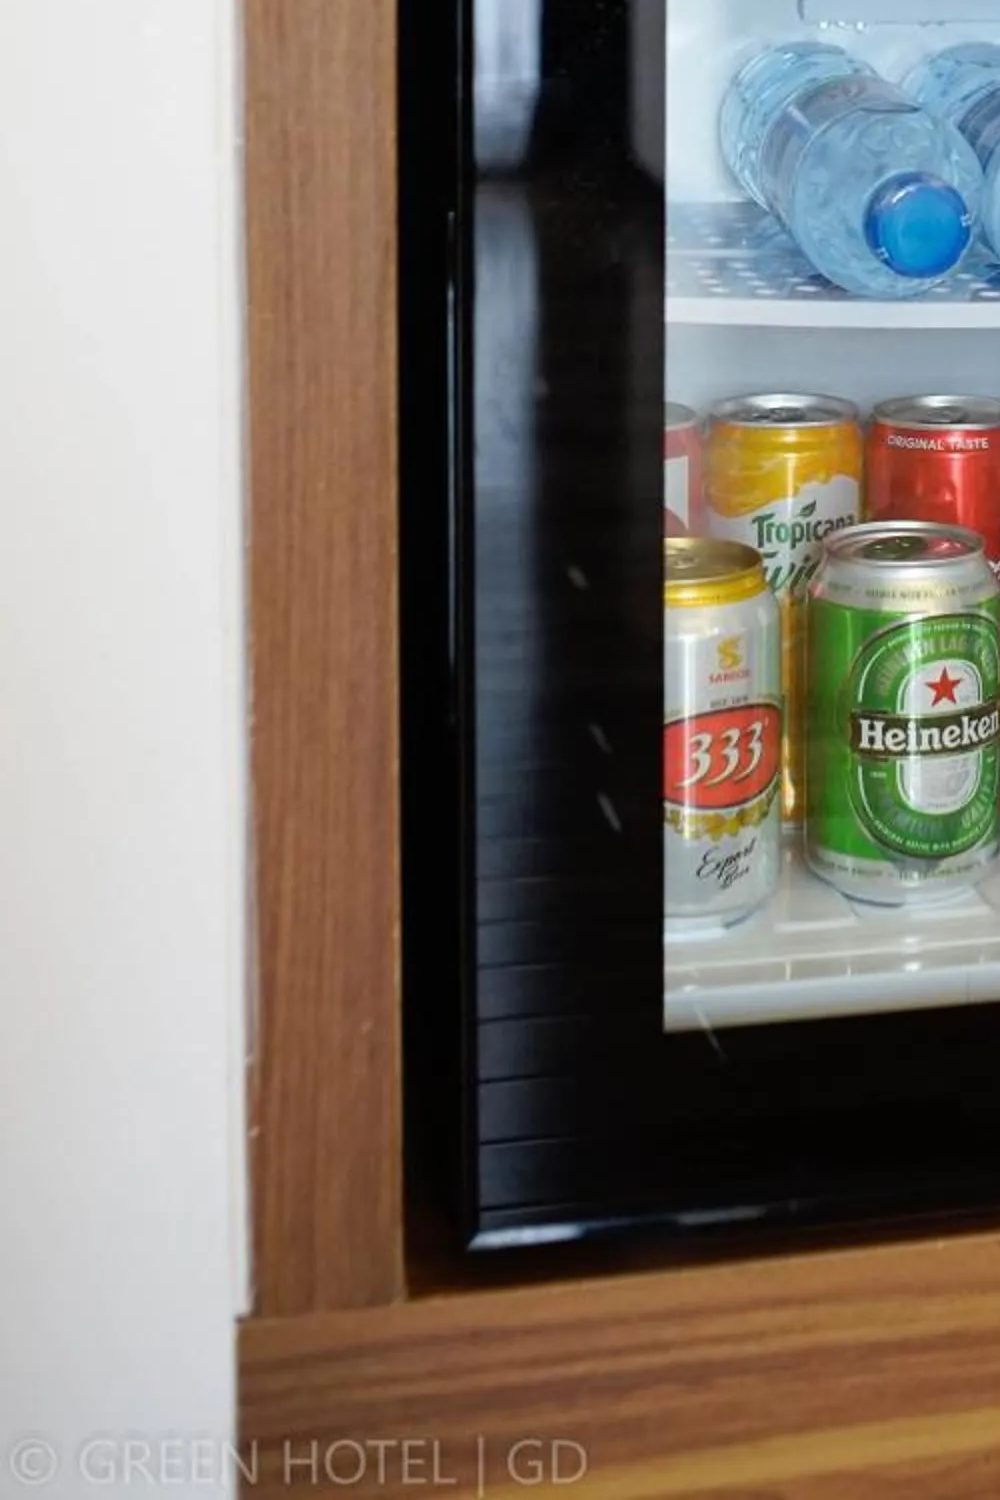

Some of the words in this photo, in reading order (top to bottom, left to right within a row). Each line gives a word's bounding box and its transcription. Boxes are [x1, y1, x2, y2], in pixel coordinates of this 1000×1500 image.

[887, 435, 945, 451] ORIGINAL
[949, 437, 989, 451] TASTE
[751, 511, 855, 550] Tropicana
[859, 710, 999, 753] Heineken
[672, 721, 764, 789] 333
